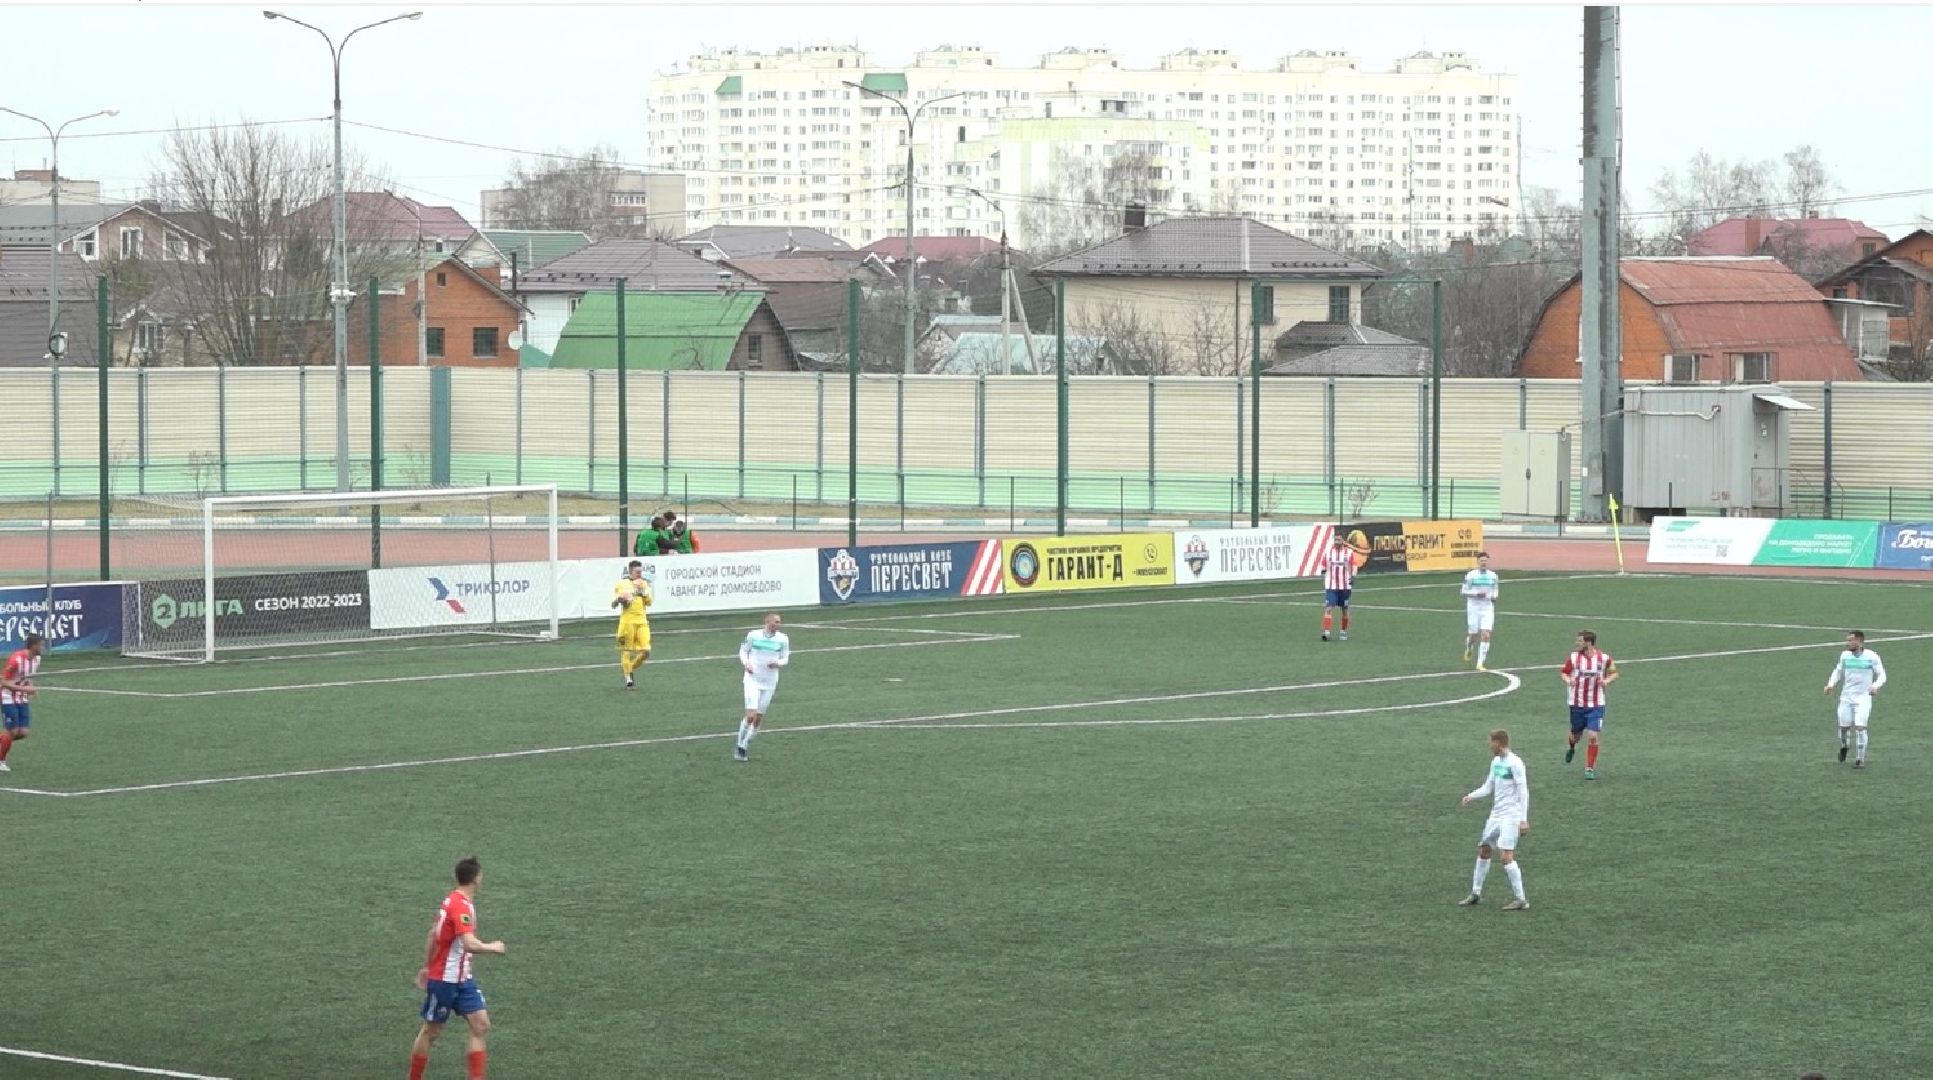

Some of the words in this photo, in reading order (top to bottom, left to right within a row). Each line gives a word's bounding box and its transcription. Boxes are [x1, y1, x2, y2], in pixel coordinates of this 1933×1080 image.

[1220, 545, 1291, 572] ПЕРЕСВЕТ
[665, 565, 718, 580] ГОРОДСКОЙ
[720, 565, 761, 578] СТАДИОН
[870, 562, 953, 593] ПЕРЕСВЕТ
[456, 580, 530, 596] ТРИКОЛОР
[721, 580, 782, 595] ДОМОДЕДОВО
[54, 600, 82, 611] КЛУБ
[255, 597, 299, 611] СЕЗОН
[301, 593, 362, 609] 2022-2023
